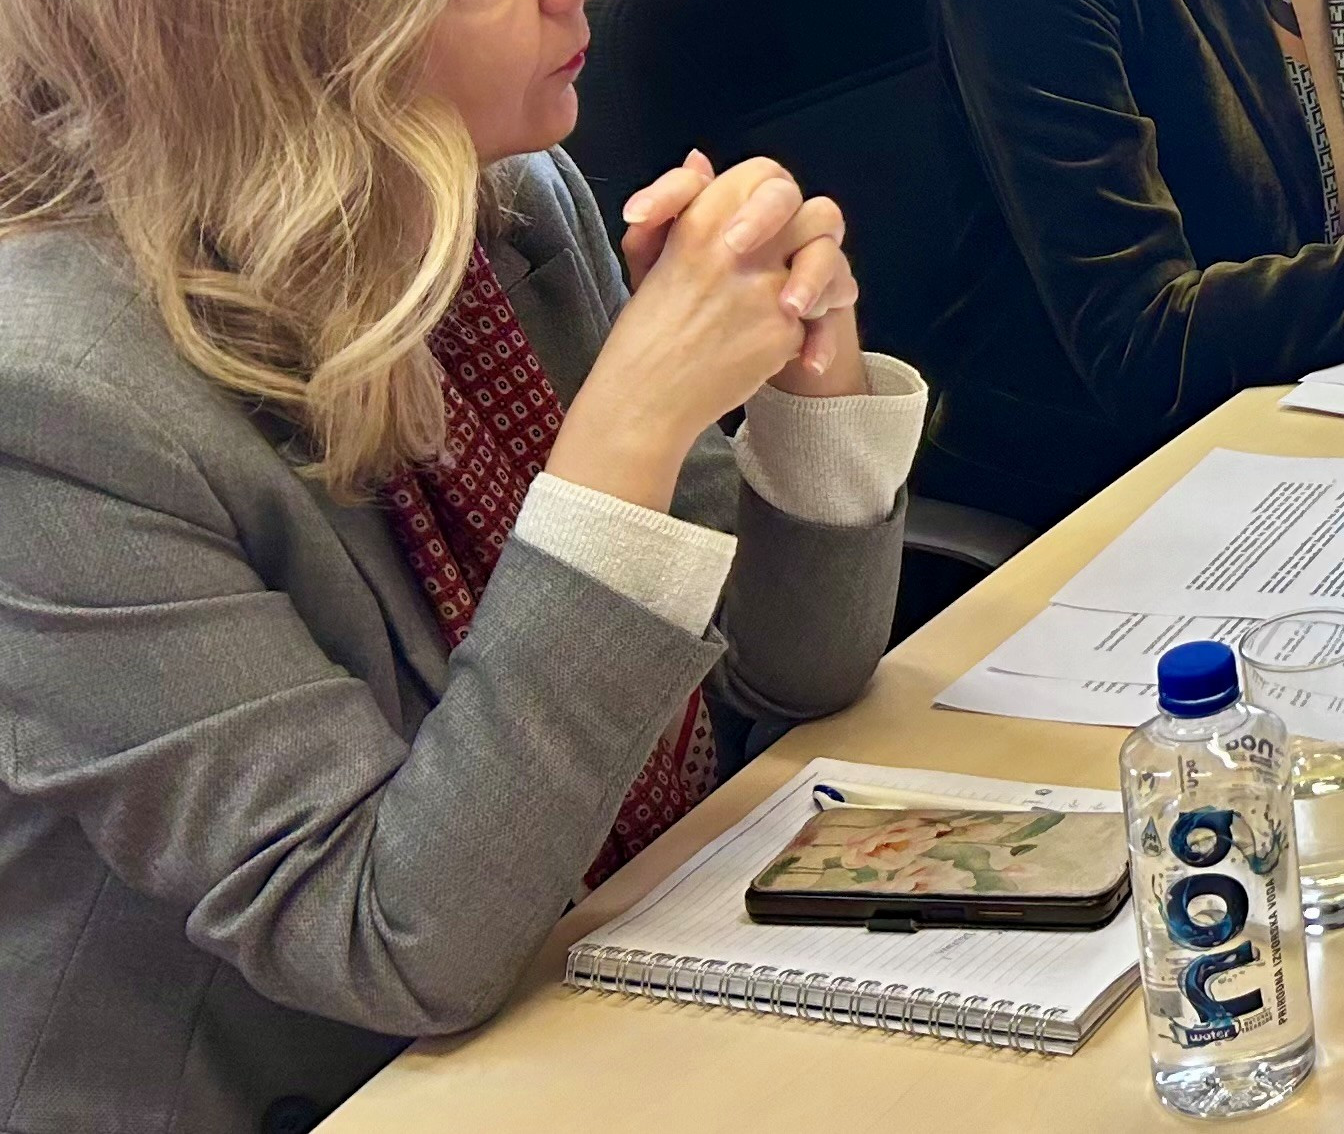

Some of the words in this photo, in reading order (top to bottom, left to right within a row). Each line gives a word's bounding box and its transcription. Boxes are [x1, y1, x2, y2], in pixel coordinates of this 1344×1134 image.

[1166, 804, 1264, 1024] noa
[1264, 878, 1277, 911] VODA
[1269, 910, 1283, 968] IZVORSKA
[1274, 969, 1288, 1026] PRIRODNA
[1189, 1027, 1231, 1042] water
